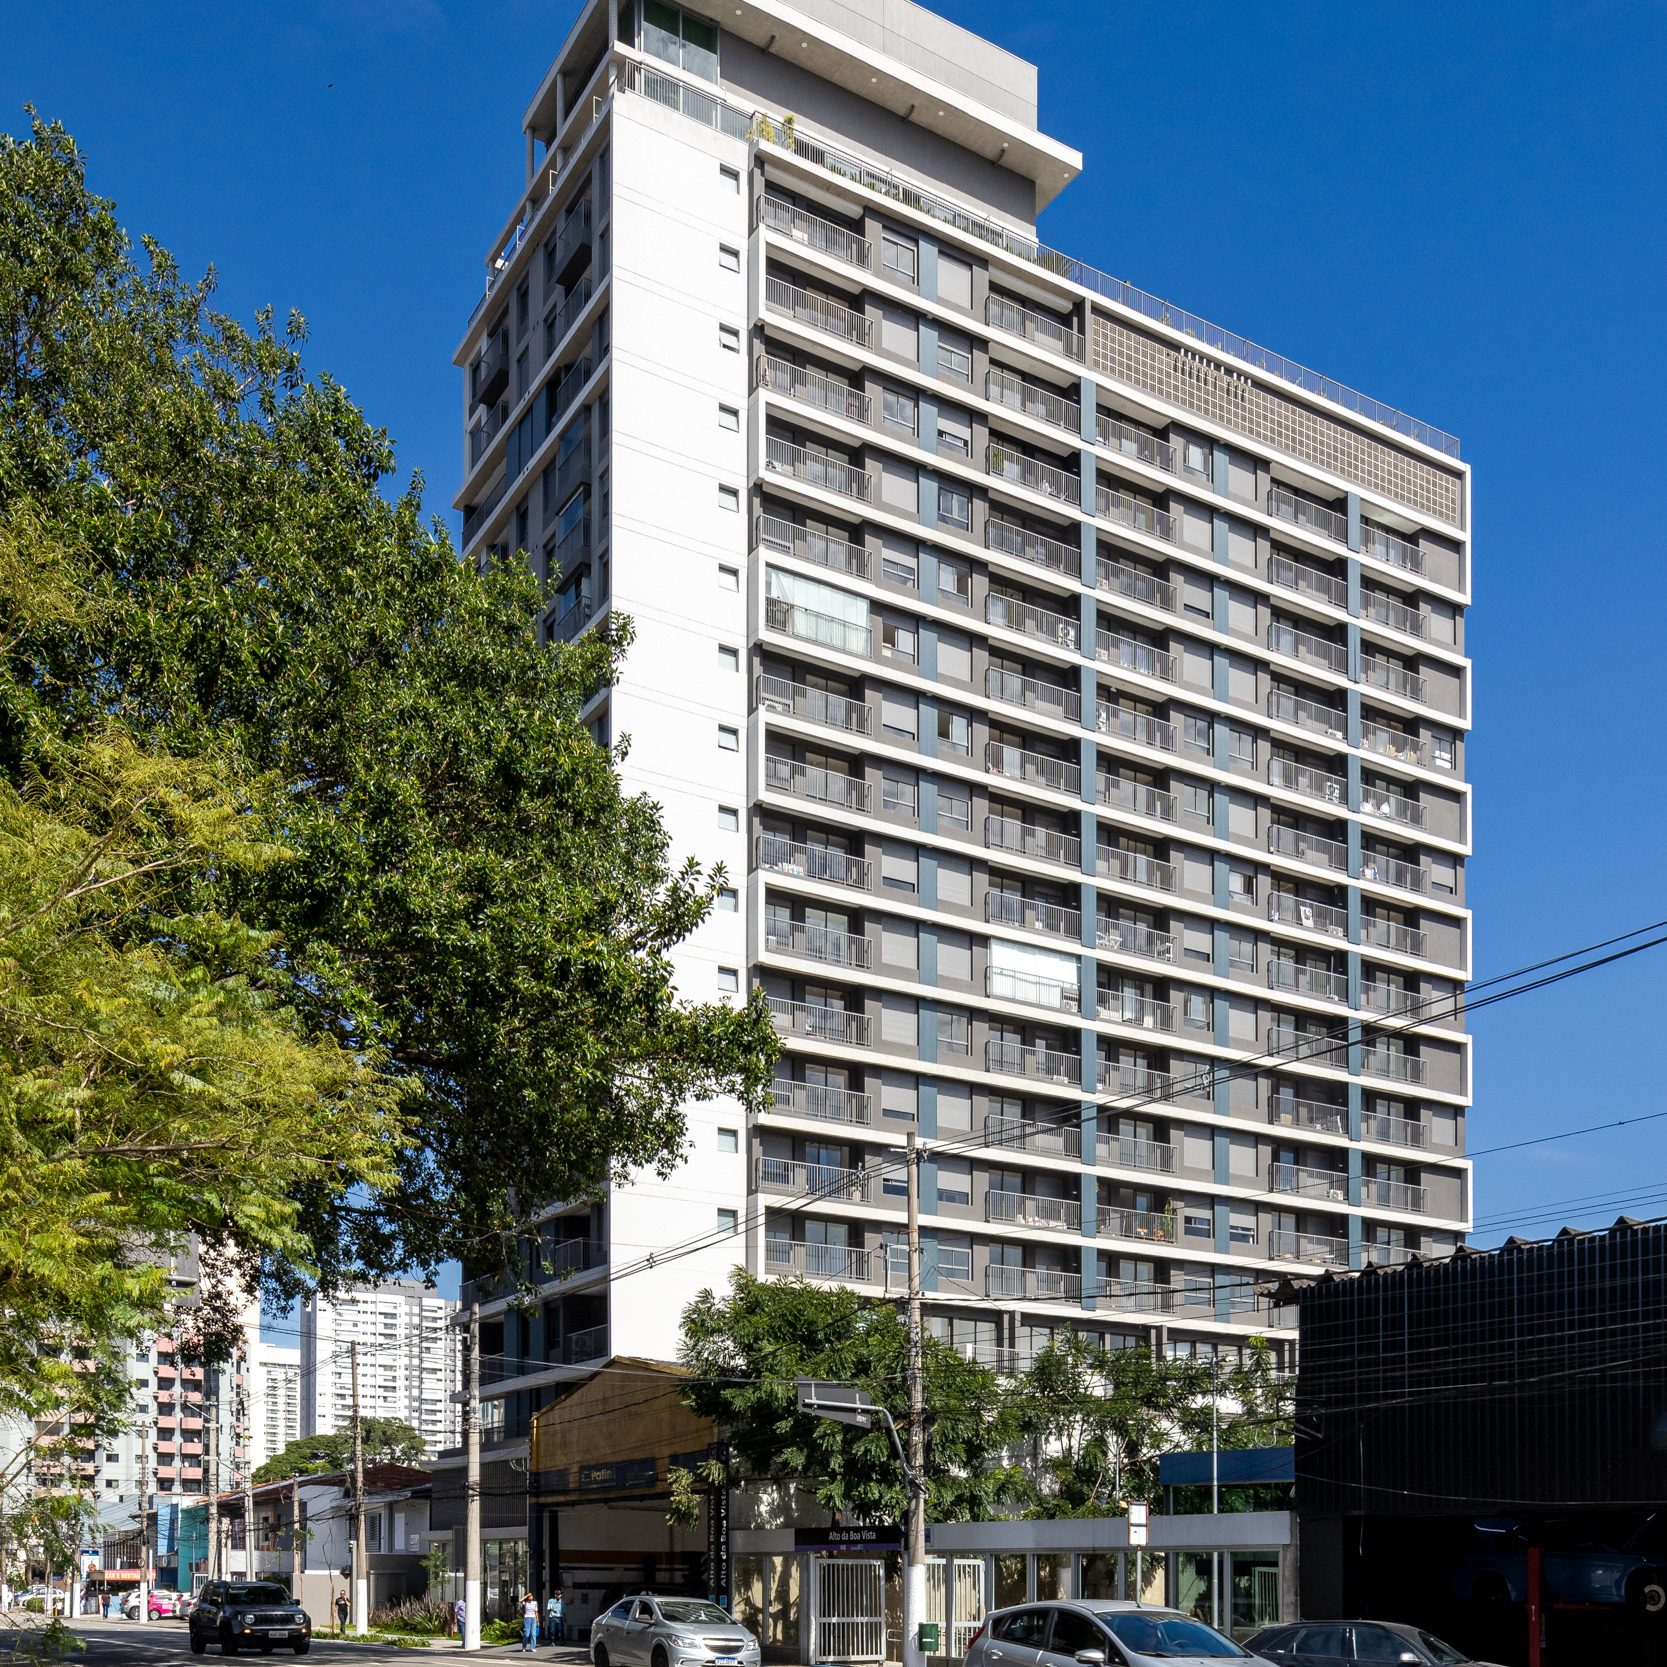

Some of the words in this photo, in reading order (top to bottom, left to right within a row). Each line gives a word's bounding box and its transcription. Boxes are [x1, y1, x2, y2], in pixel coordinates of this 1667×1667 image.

[829, 1532, 840, 1541] Alto
[842, 1531, 849, 1540] da
[850, 1531, 861, 1540] Boa
[862, 1530, 876, 1540] Vista
[720, 1545, 727, 1560] da
